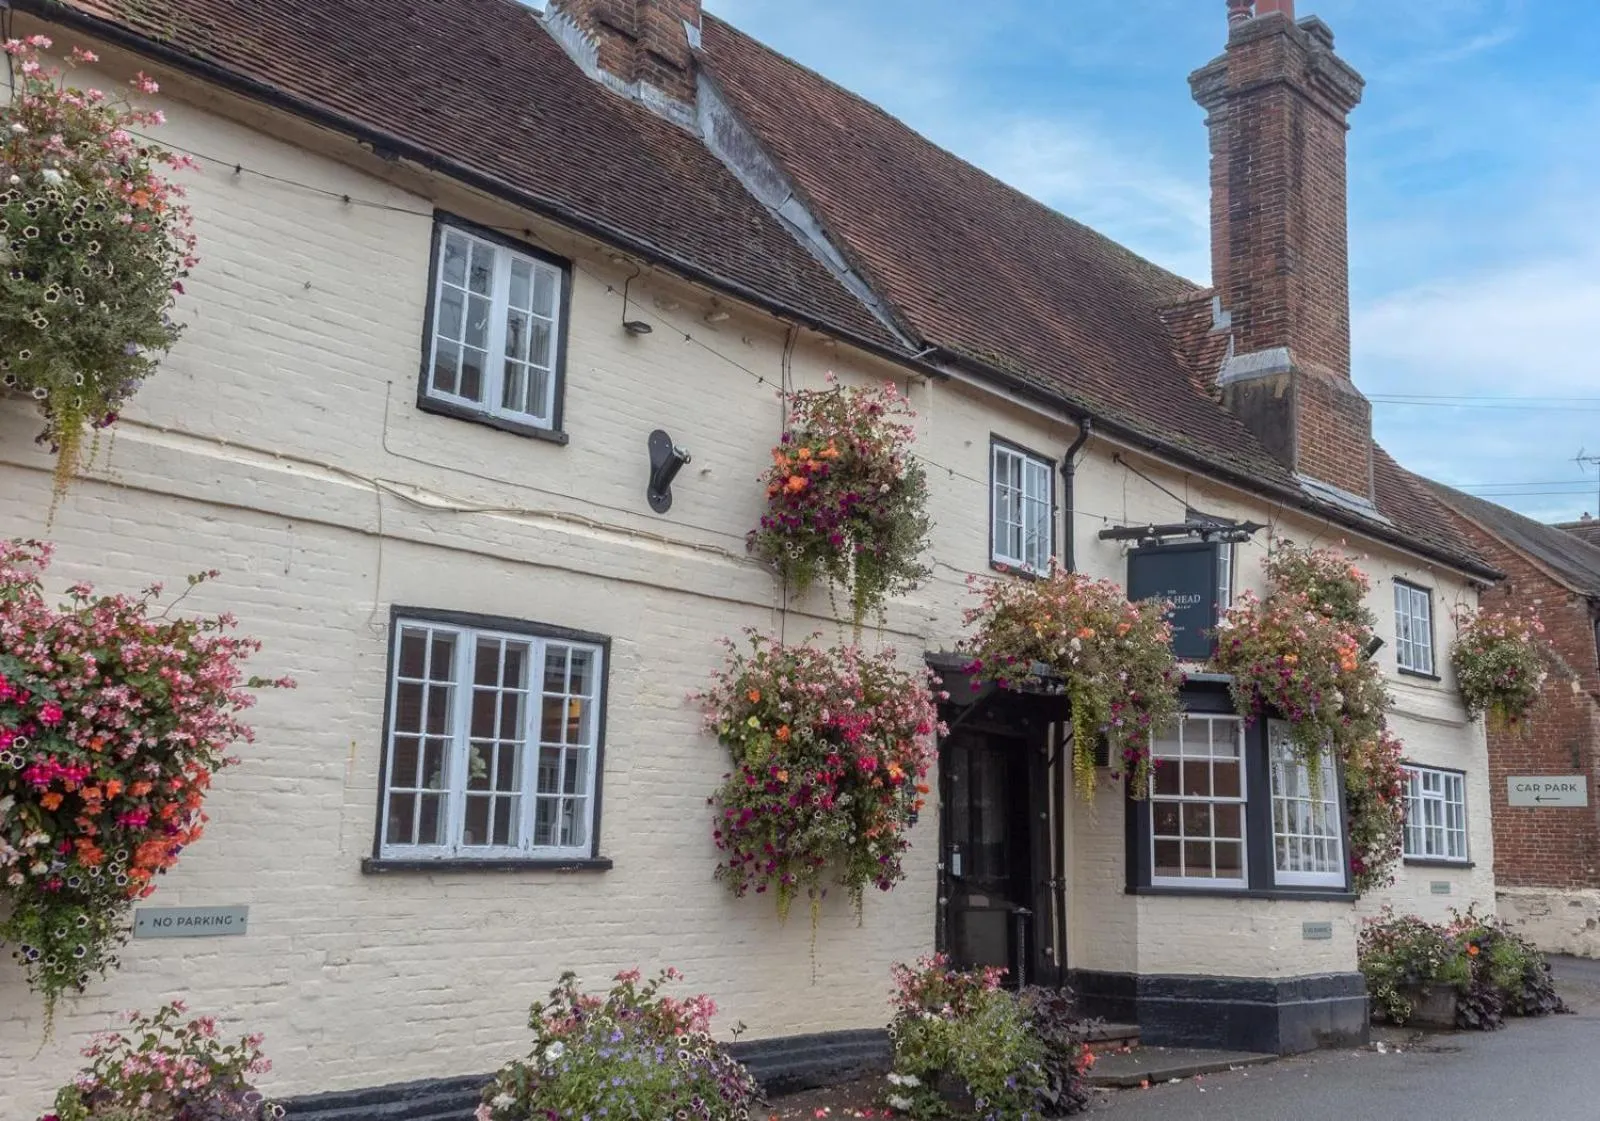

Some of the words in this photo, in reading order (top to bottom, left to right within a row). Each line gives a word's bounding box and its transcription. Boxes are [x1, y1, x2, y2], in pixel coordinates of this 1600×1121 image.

[1174, 594, 1201, 604] HEAD
[1516, 783, 1540, 793] CAR
[1545, 783, 1577, 793] PARK
[153, 917, 173, 928] NO
[177, 915, 233, 927] PARKING
